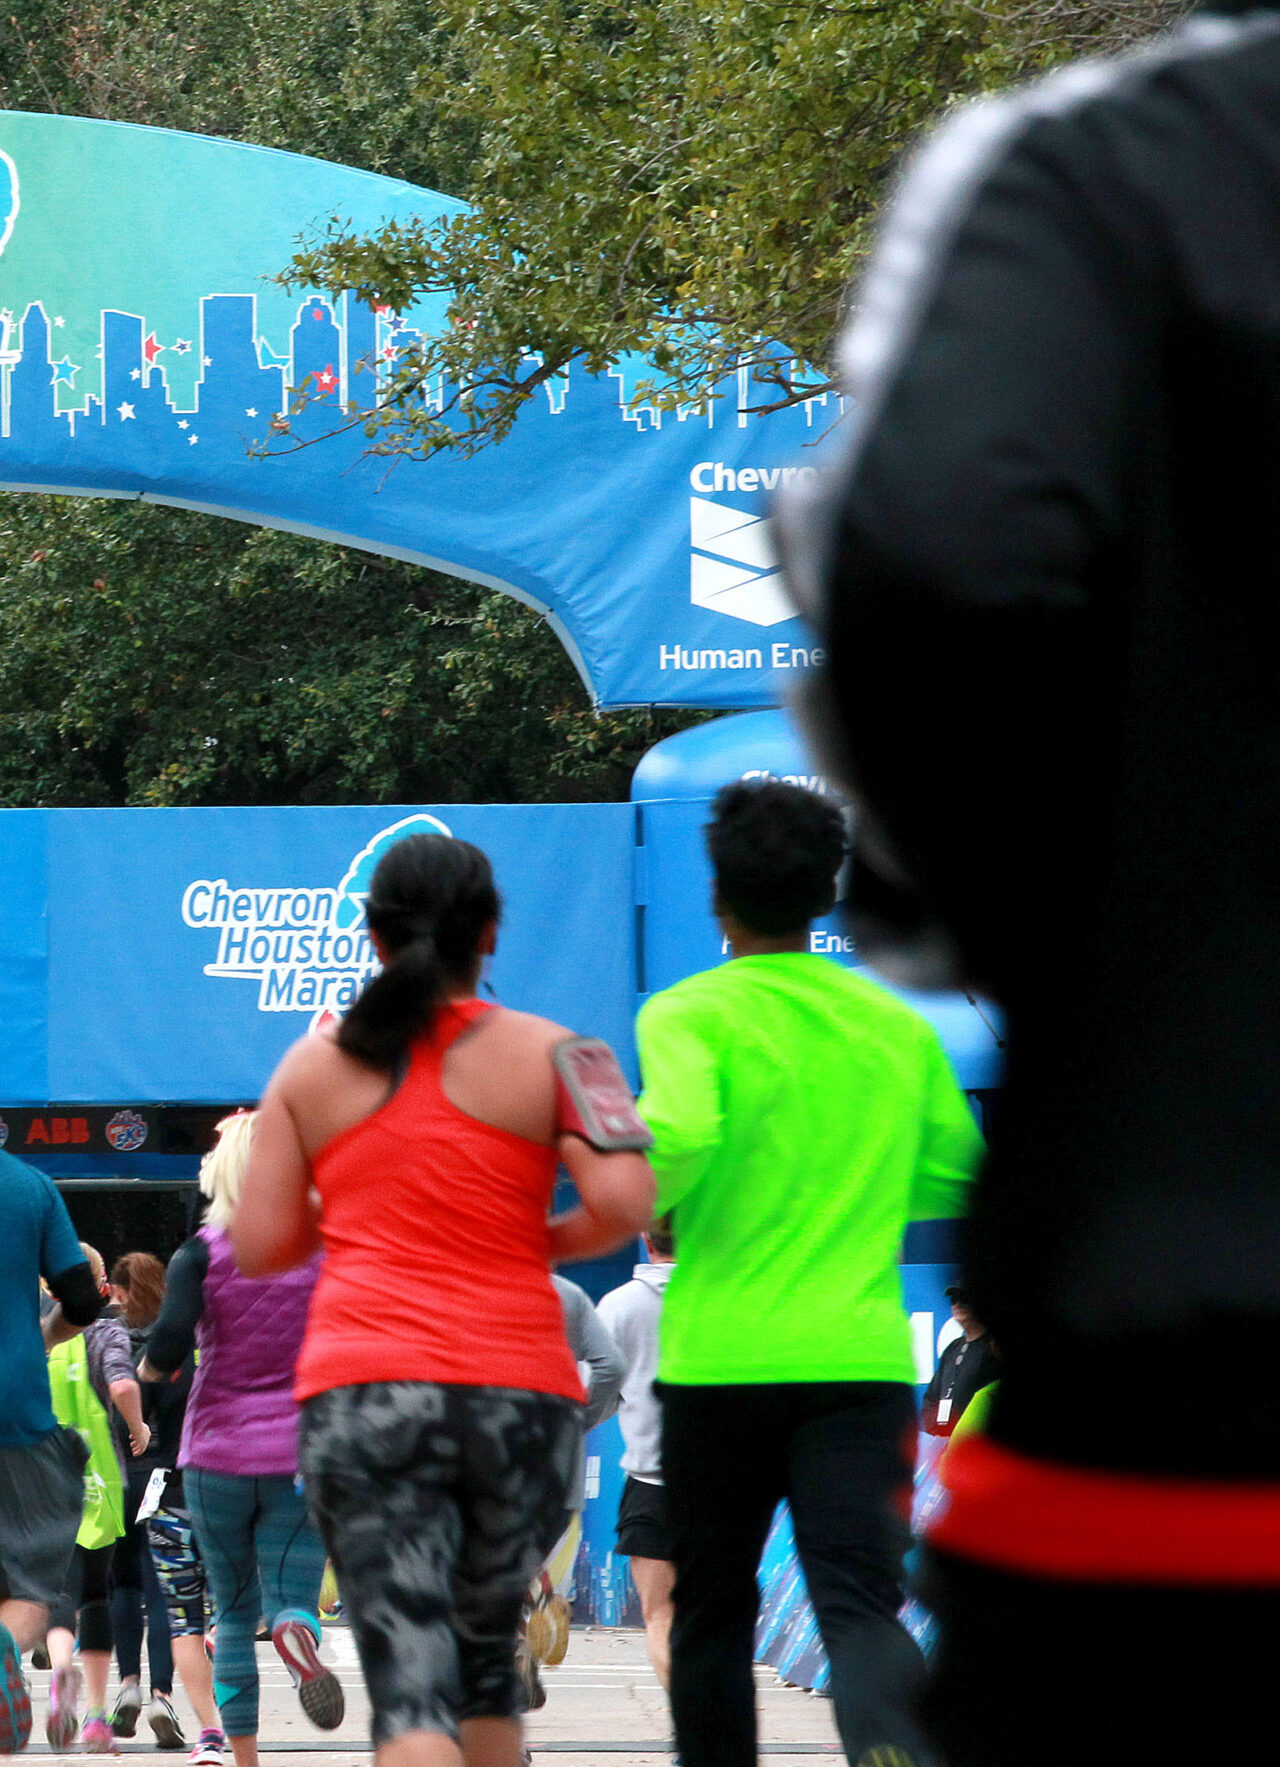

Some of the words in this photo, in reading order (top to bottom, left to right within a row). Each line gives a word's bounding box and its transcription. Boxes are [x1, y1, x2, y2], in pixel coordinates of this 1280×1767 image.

[689, 461, 821, 493] Chevro
[659, 643, 763, 670] Human
[771, 642, 827, 669] Ene
[187, 884, 335, 923] Chevron
[222, 926, 376, 964] Houston
[810, 930, 856, 953] Ene
[24, 1117, 91, 1145] ABB
